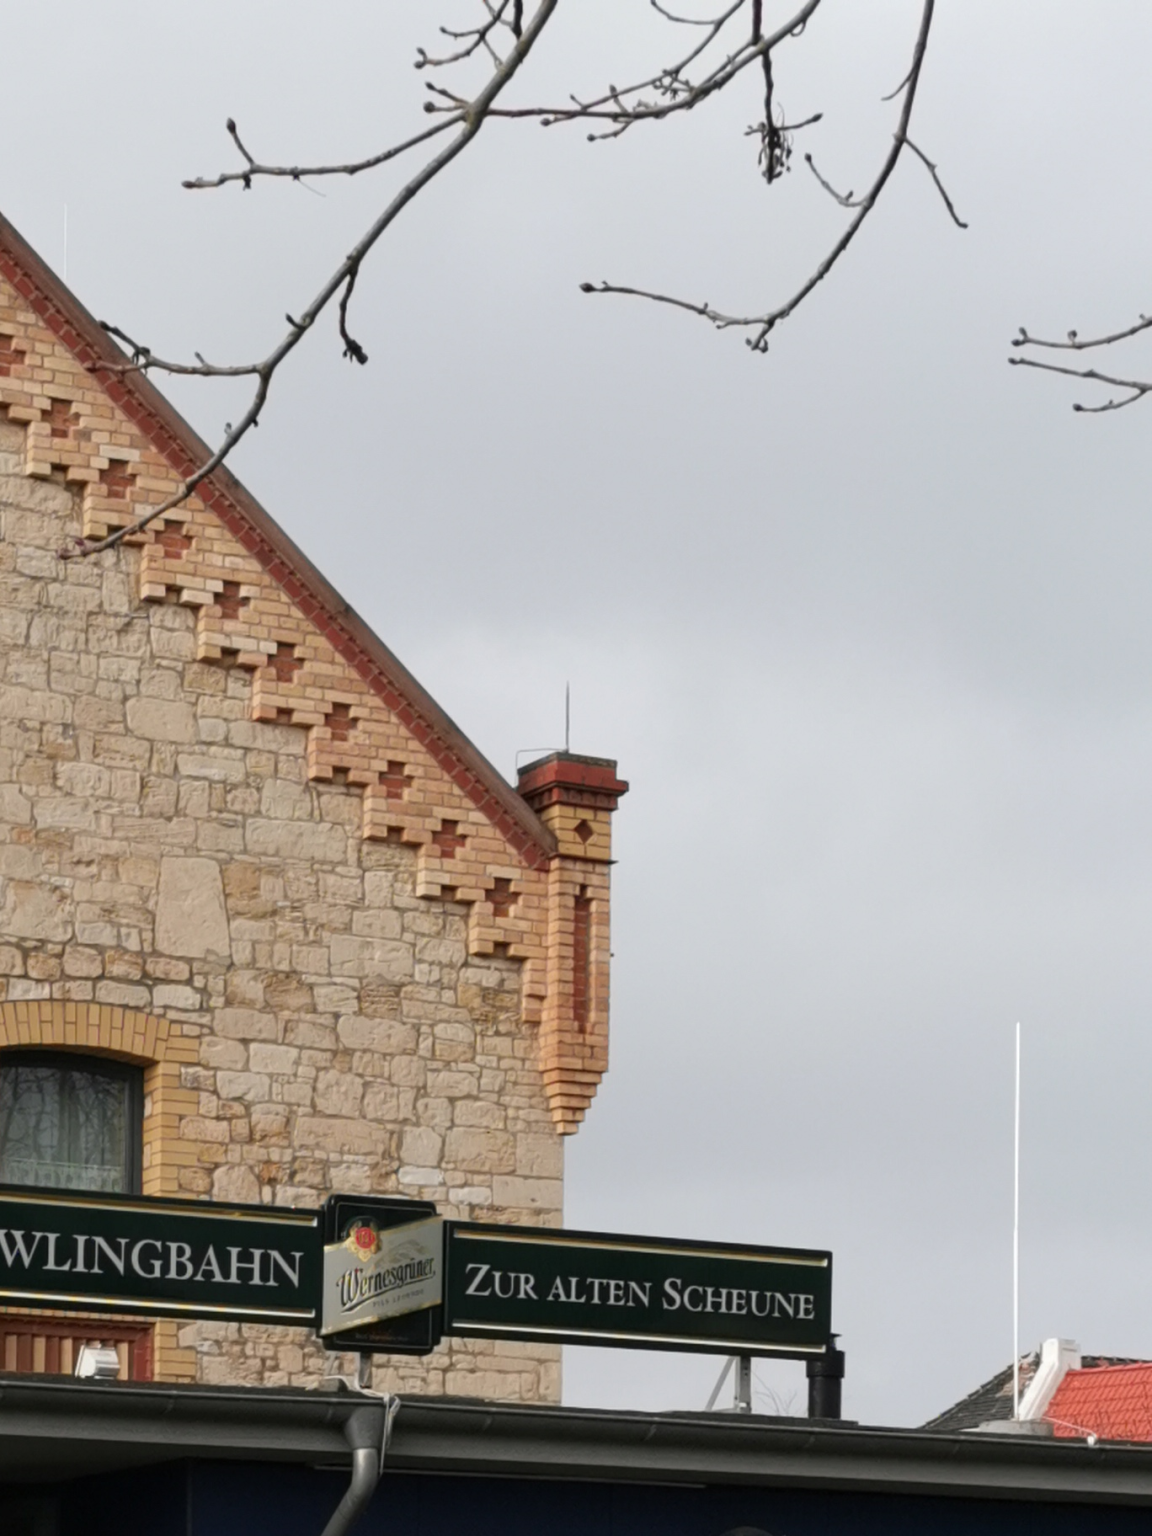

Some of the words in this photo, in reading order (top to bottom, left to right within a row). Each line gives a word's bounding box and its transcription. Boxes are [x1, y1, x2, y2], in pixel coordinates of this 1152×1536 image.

[336, 1257, 436, 1307] Wernesgrüner
[465, 1263, 539, 1301] ZUR
[548, 1275, 652, 1308] ALTEN
[663, 1278, 815, 1320] SCHEUNE
